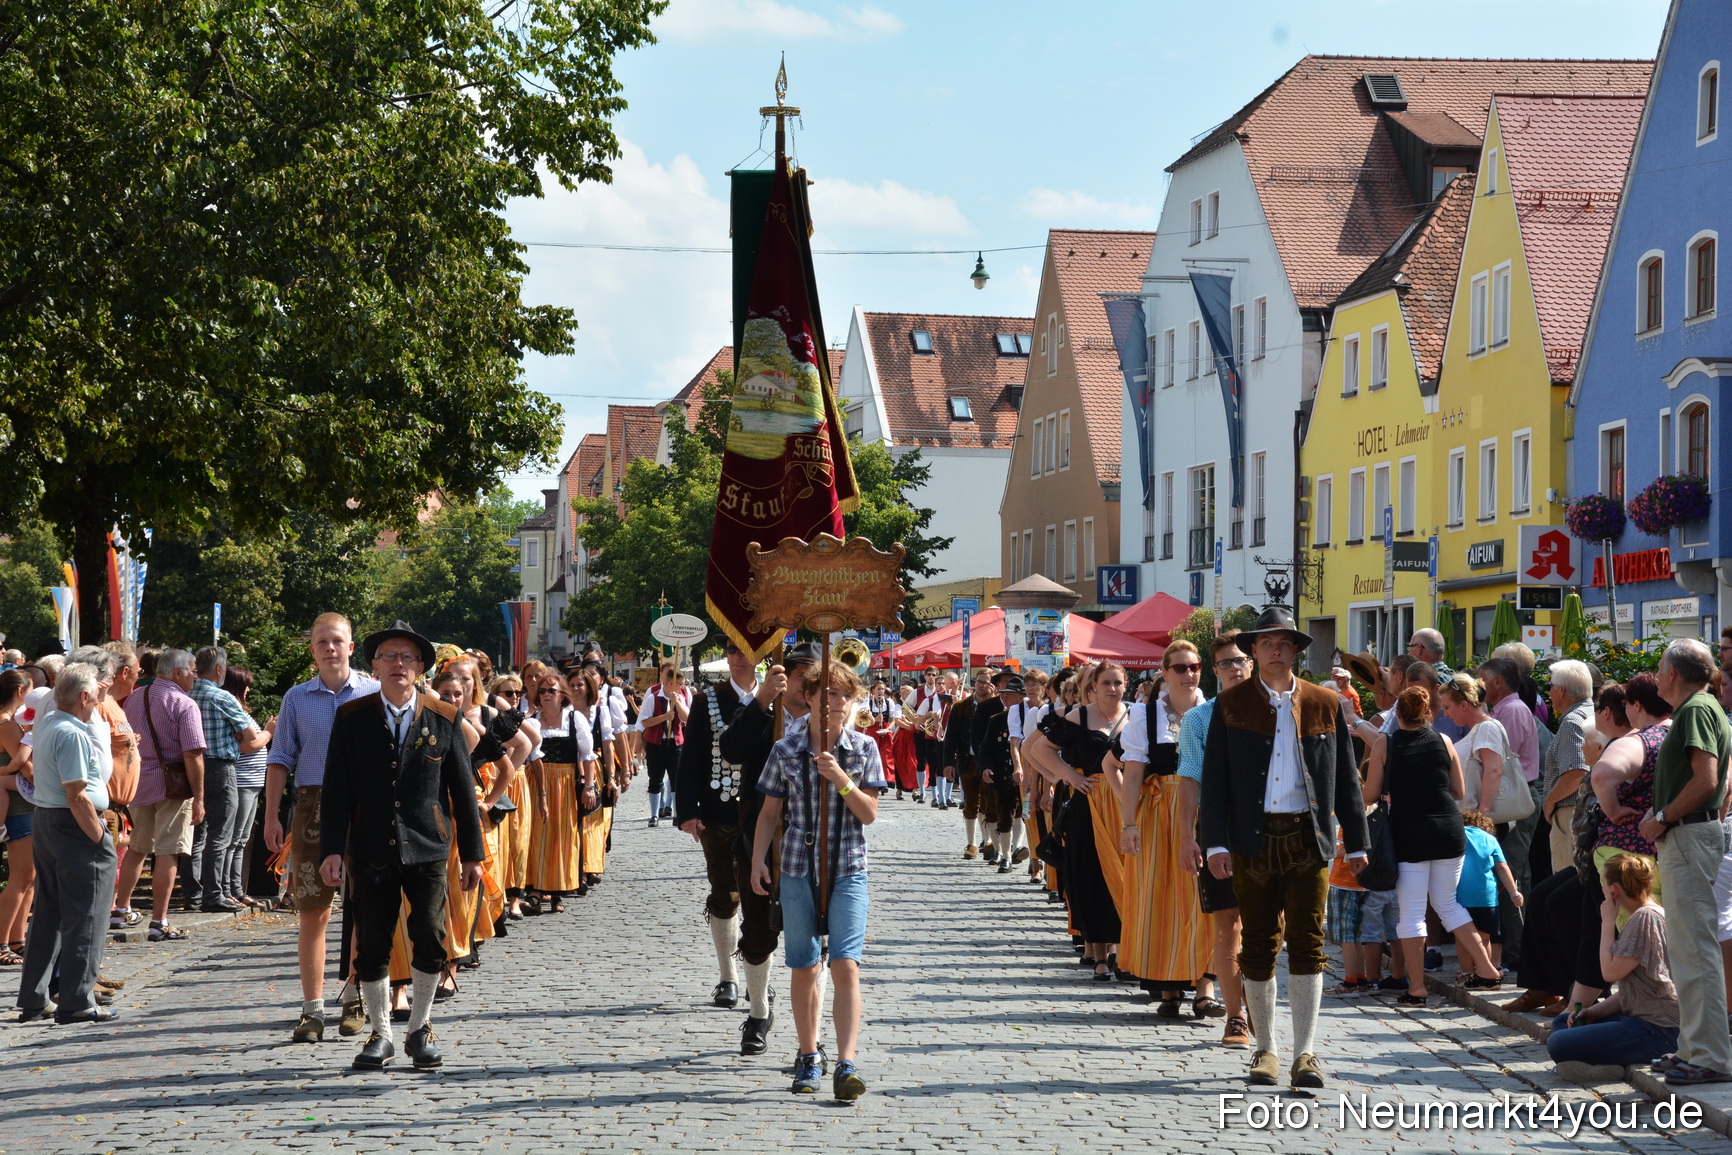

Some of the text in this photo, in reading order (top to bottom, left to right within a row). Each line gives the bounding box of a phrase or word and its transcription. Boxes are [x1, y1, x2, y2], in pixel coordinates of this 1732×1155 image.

[1357, 419, 1430, 458] HOTEL Lehmeier
[1392, 560, 1429, 568] TAIFUN
[1430, 542, 1436, 572] P
[1465, 545, 1495, 565] TAIFUN
[1590, 548, 1671, 587] AOTHEKE
[1650, 602, 1692, 615] RATHAUS APOTHEKE
[883, 632, 899, 641] TAXI
